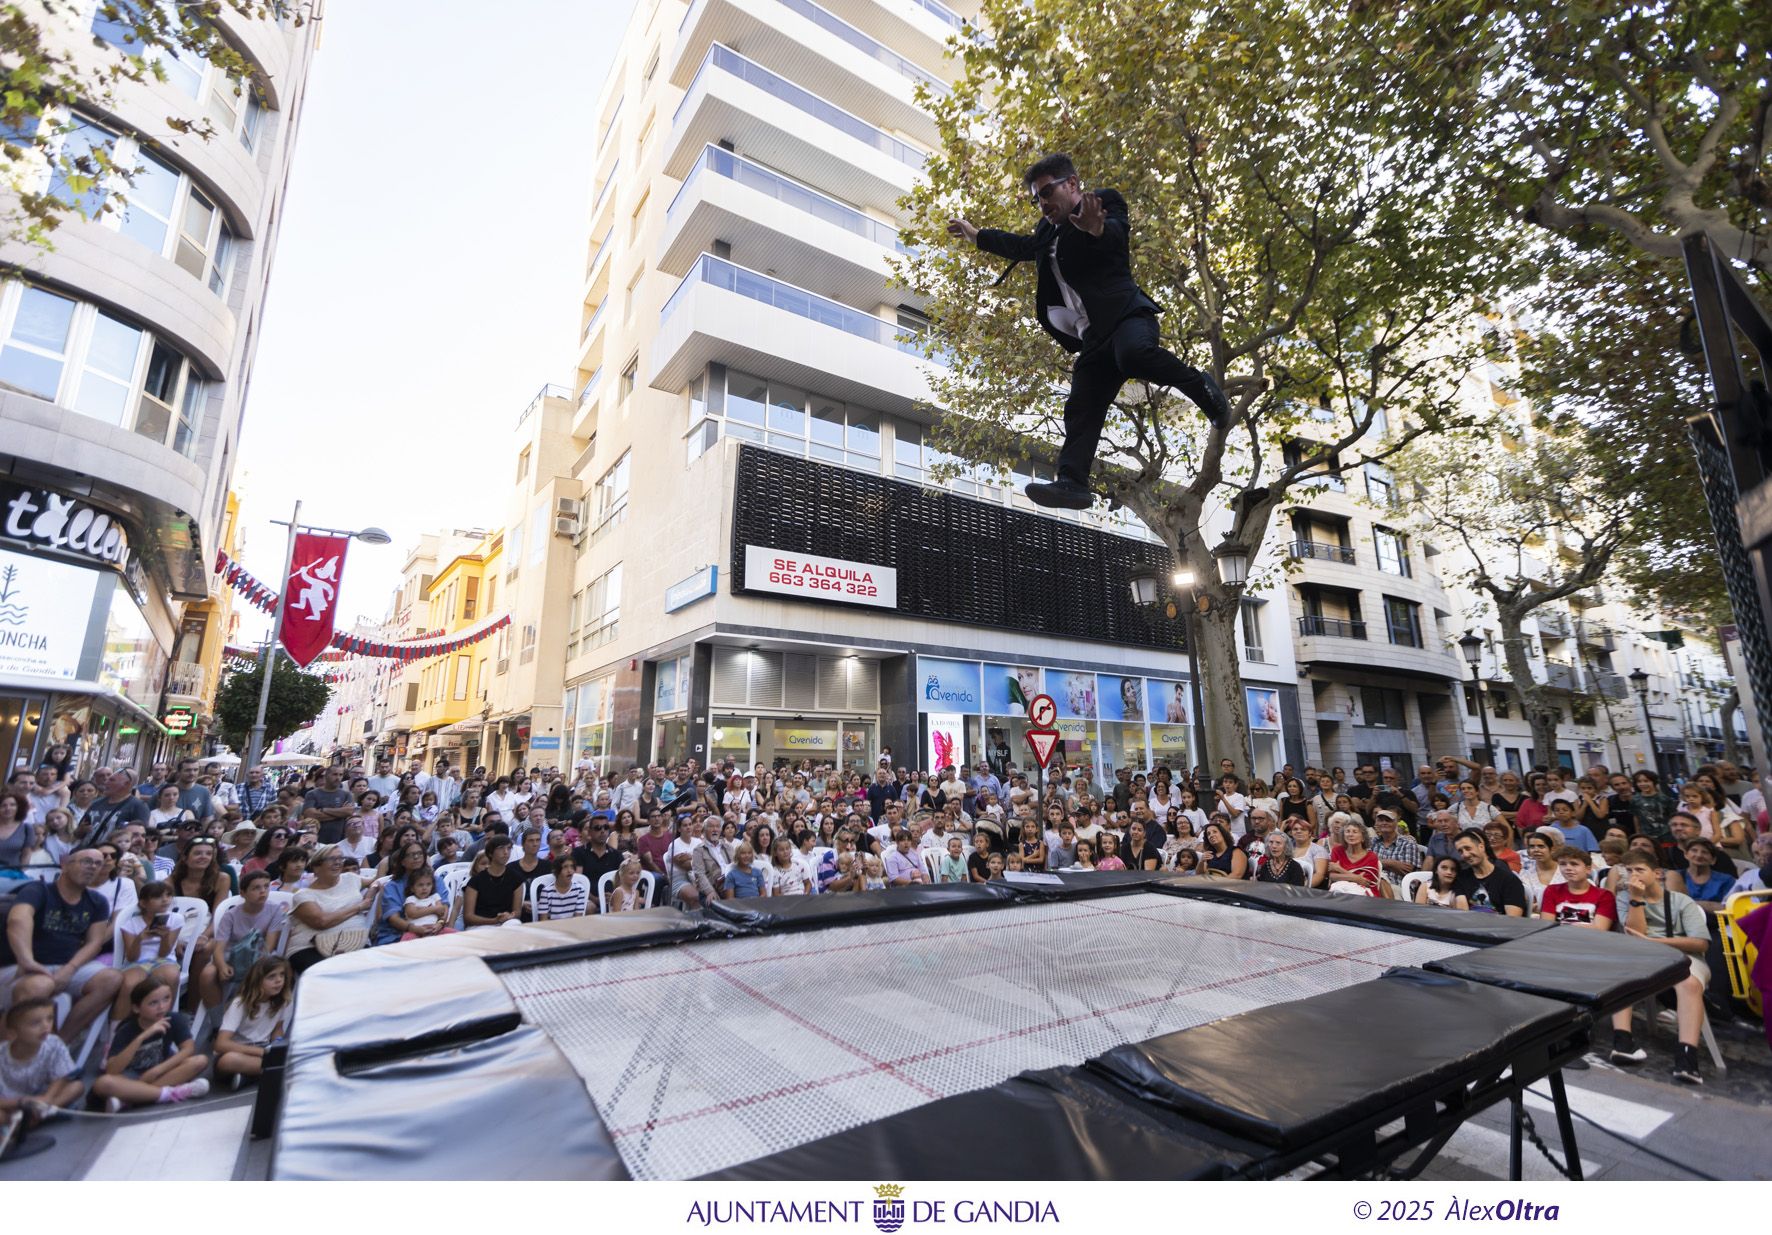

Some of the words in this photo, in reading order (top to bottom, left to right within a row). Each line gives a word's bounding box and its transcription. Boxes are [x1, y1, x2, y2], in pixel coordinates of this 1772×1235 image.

[769, 571, 804, 587] 663
[809, 577, 842, 592] 364
[846, 583, 878, 597] 322
[774, 558, 797, 572] SE
[802, 563, 873, 584] ALQUILA
